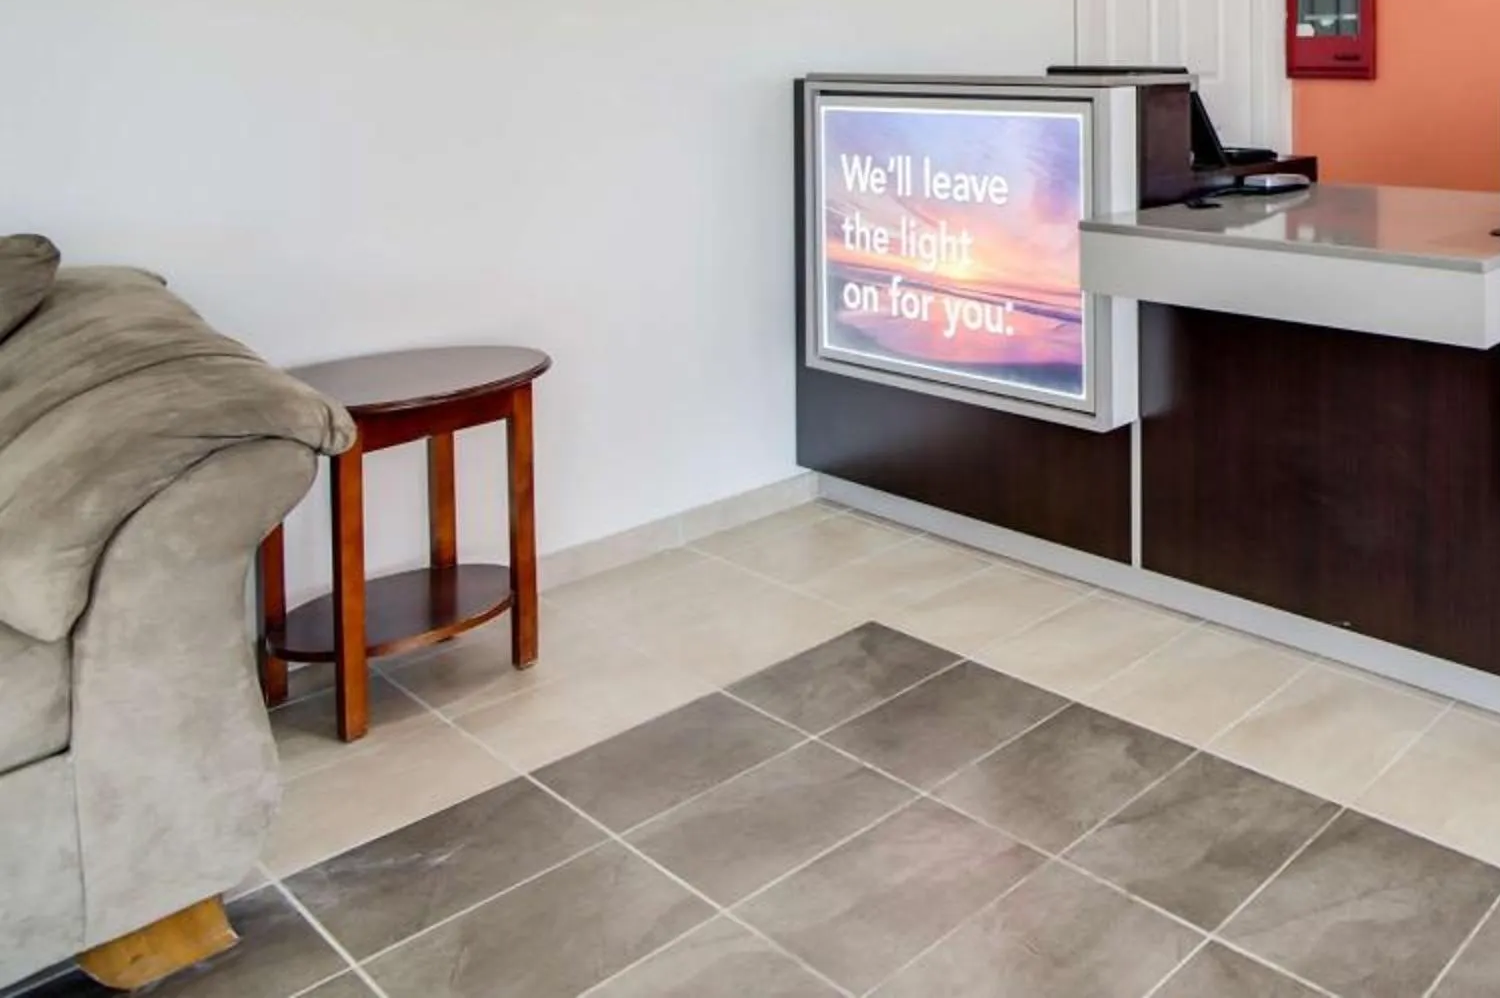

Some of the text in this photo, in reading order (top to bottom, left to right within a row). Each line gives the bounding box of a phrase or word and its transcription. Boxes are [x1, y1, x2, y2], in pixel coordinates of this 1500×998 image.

[924, 156, 1009, 204] leave
[841, 212, 974, 271] the light
[843, 281, 879, 313] on
[888, 276, 933, 320] for
